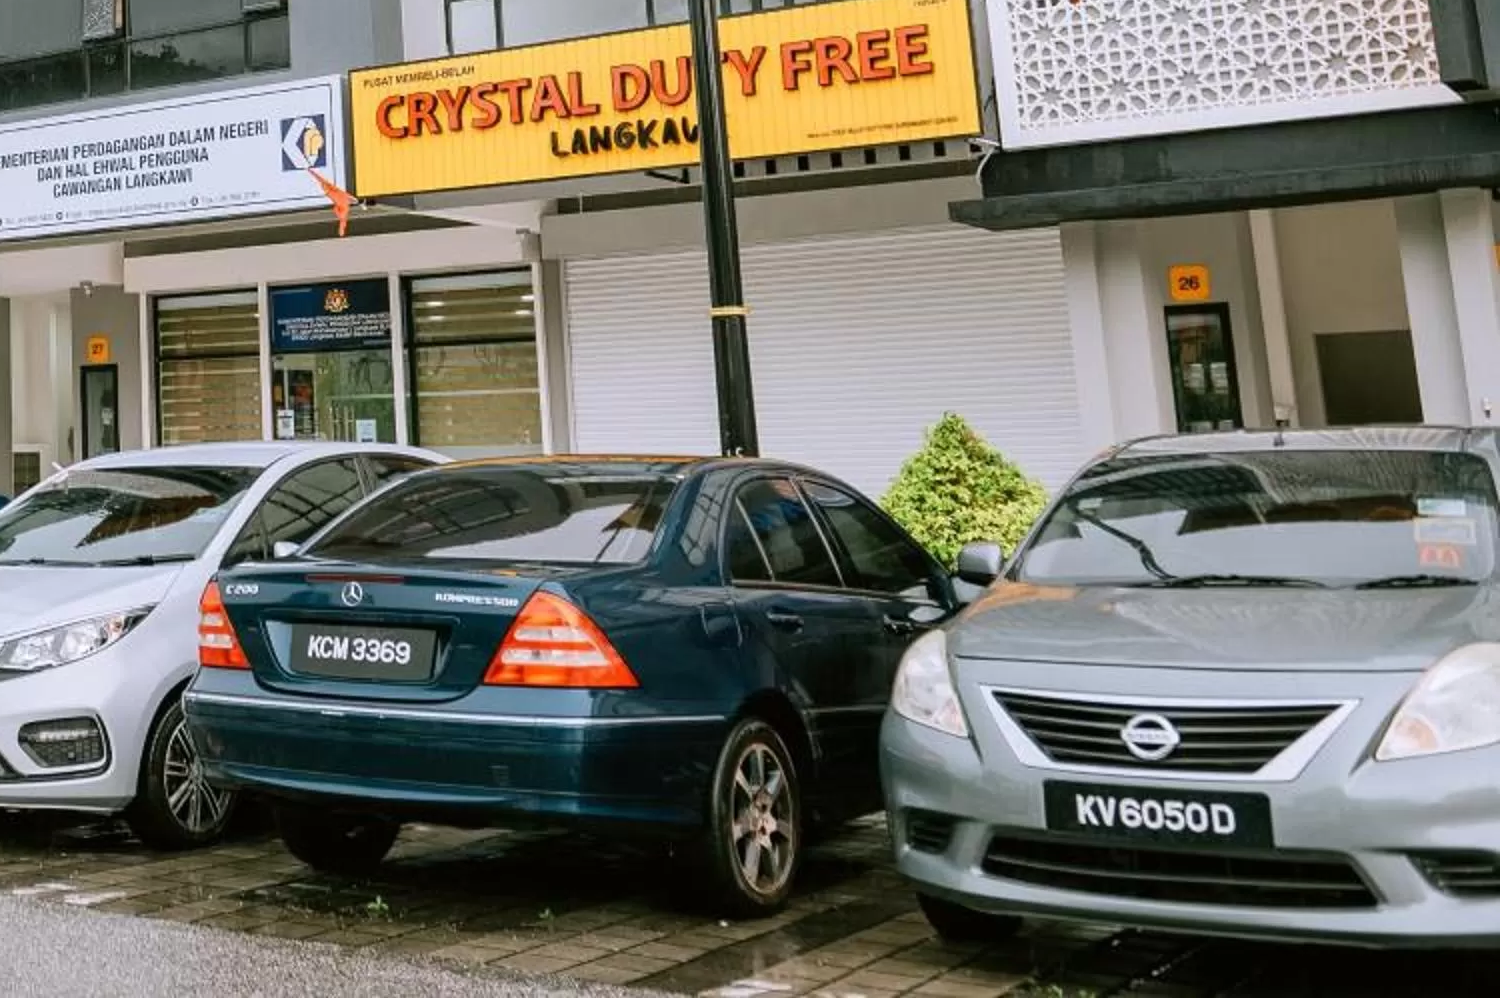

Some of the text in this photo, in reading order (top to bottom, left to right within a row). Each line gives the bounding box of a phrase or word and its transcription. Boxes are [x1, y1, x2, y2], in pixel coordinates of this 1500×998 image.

[363, 75, 394, 89] PUSAT
[375, 22, 934, 139] CRYSTAL DUY FREE
[73, 133, 166, 160] PERDAGANGAN
[169, 126, 216, 147] DALAM
[219, 119, 269, 141] NEGERI
[551, 114, 700, 158] LANGKAW
[37, 147, 210, 183] DAN HAL EHWAL PENGGUNA
[53, 167, 194, 199] CAWANGAN LANGKAWI
[1178, 275, 1200, 292] 26
[307, 634, 412, 665] KCM 3369
